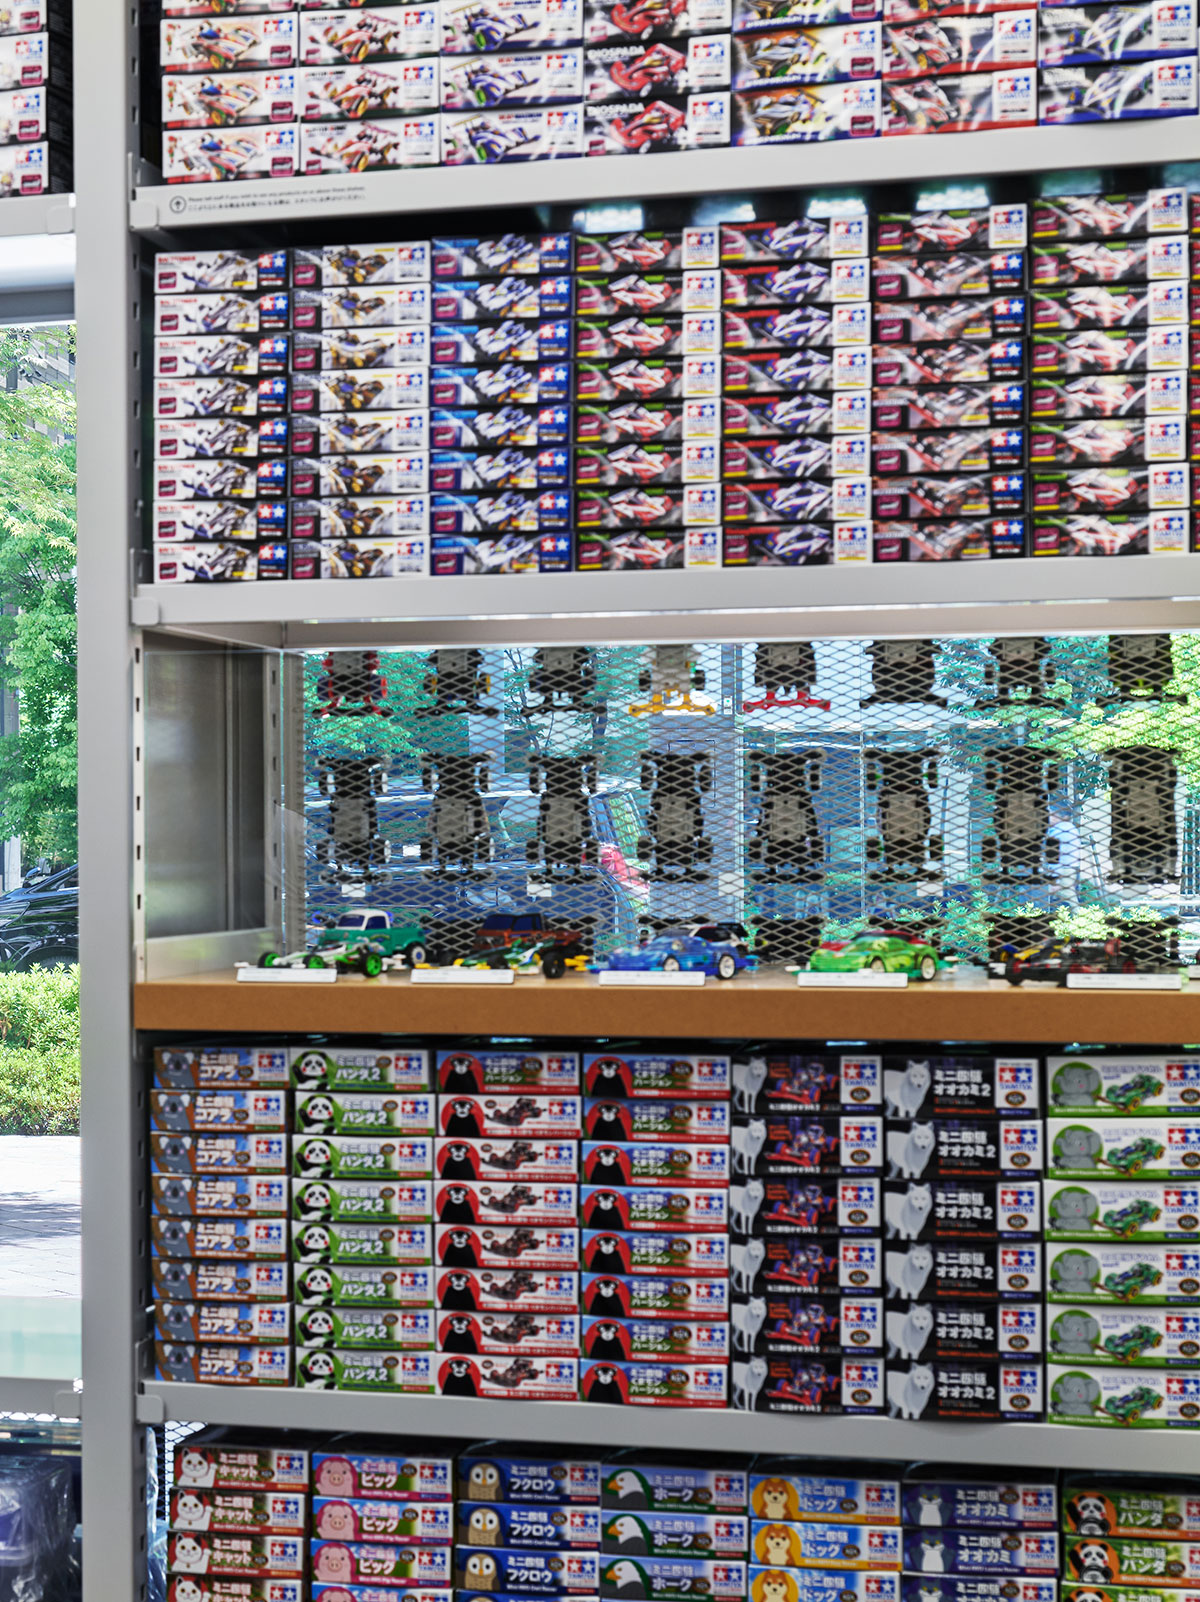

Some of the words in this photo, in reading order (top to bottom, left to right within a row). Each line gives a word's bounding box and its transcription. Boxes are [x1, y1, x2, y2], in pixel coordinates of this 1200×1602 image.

[510, 1478, 555, 1492] フクロウ
[1120, 1512, 1164, 1526] パンダ
[510, 1524, 555, 1537] フクロウ
[1122, 1560, 1166, 1574] パンダ
[507, 1570, 552, 1583] フクロウ
